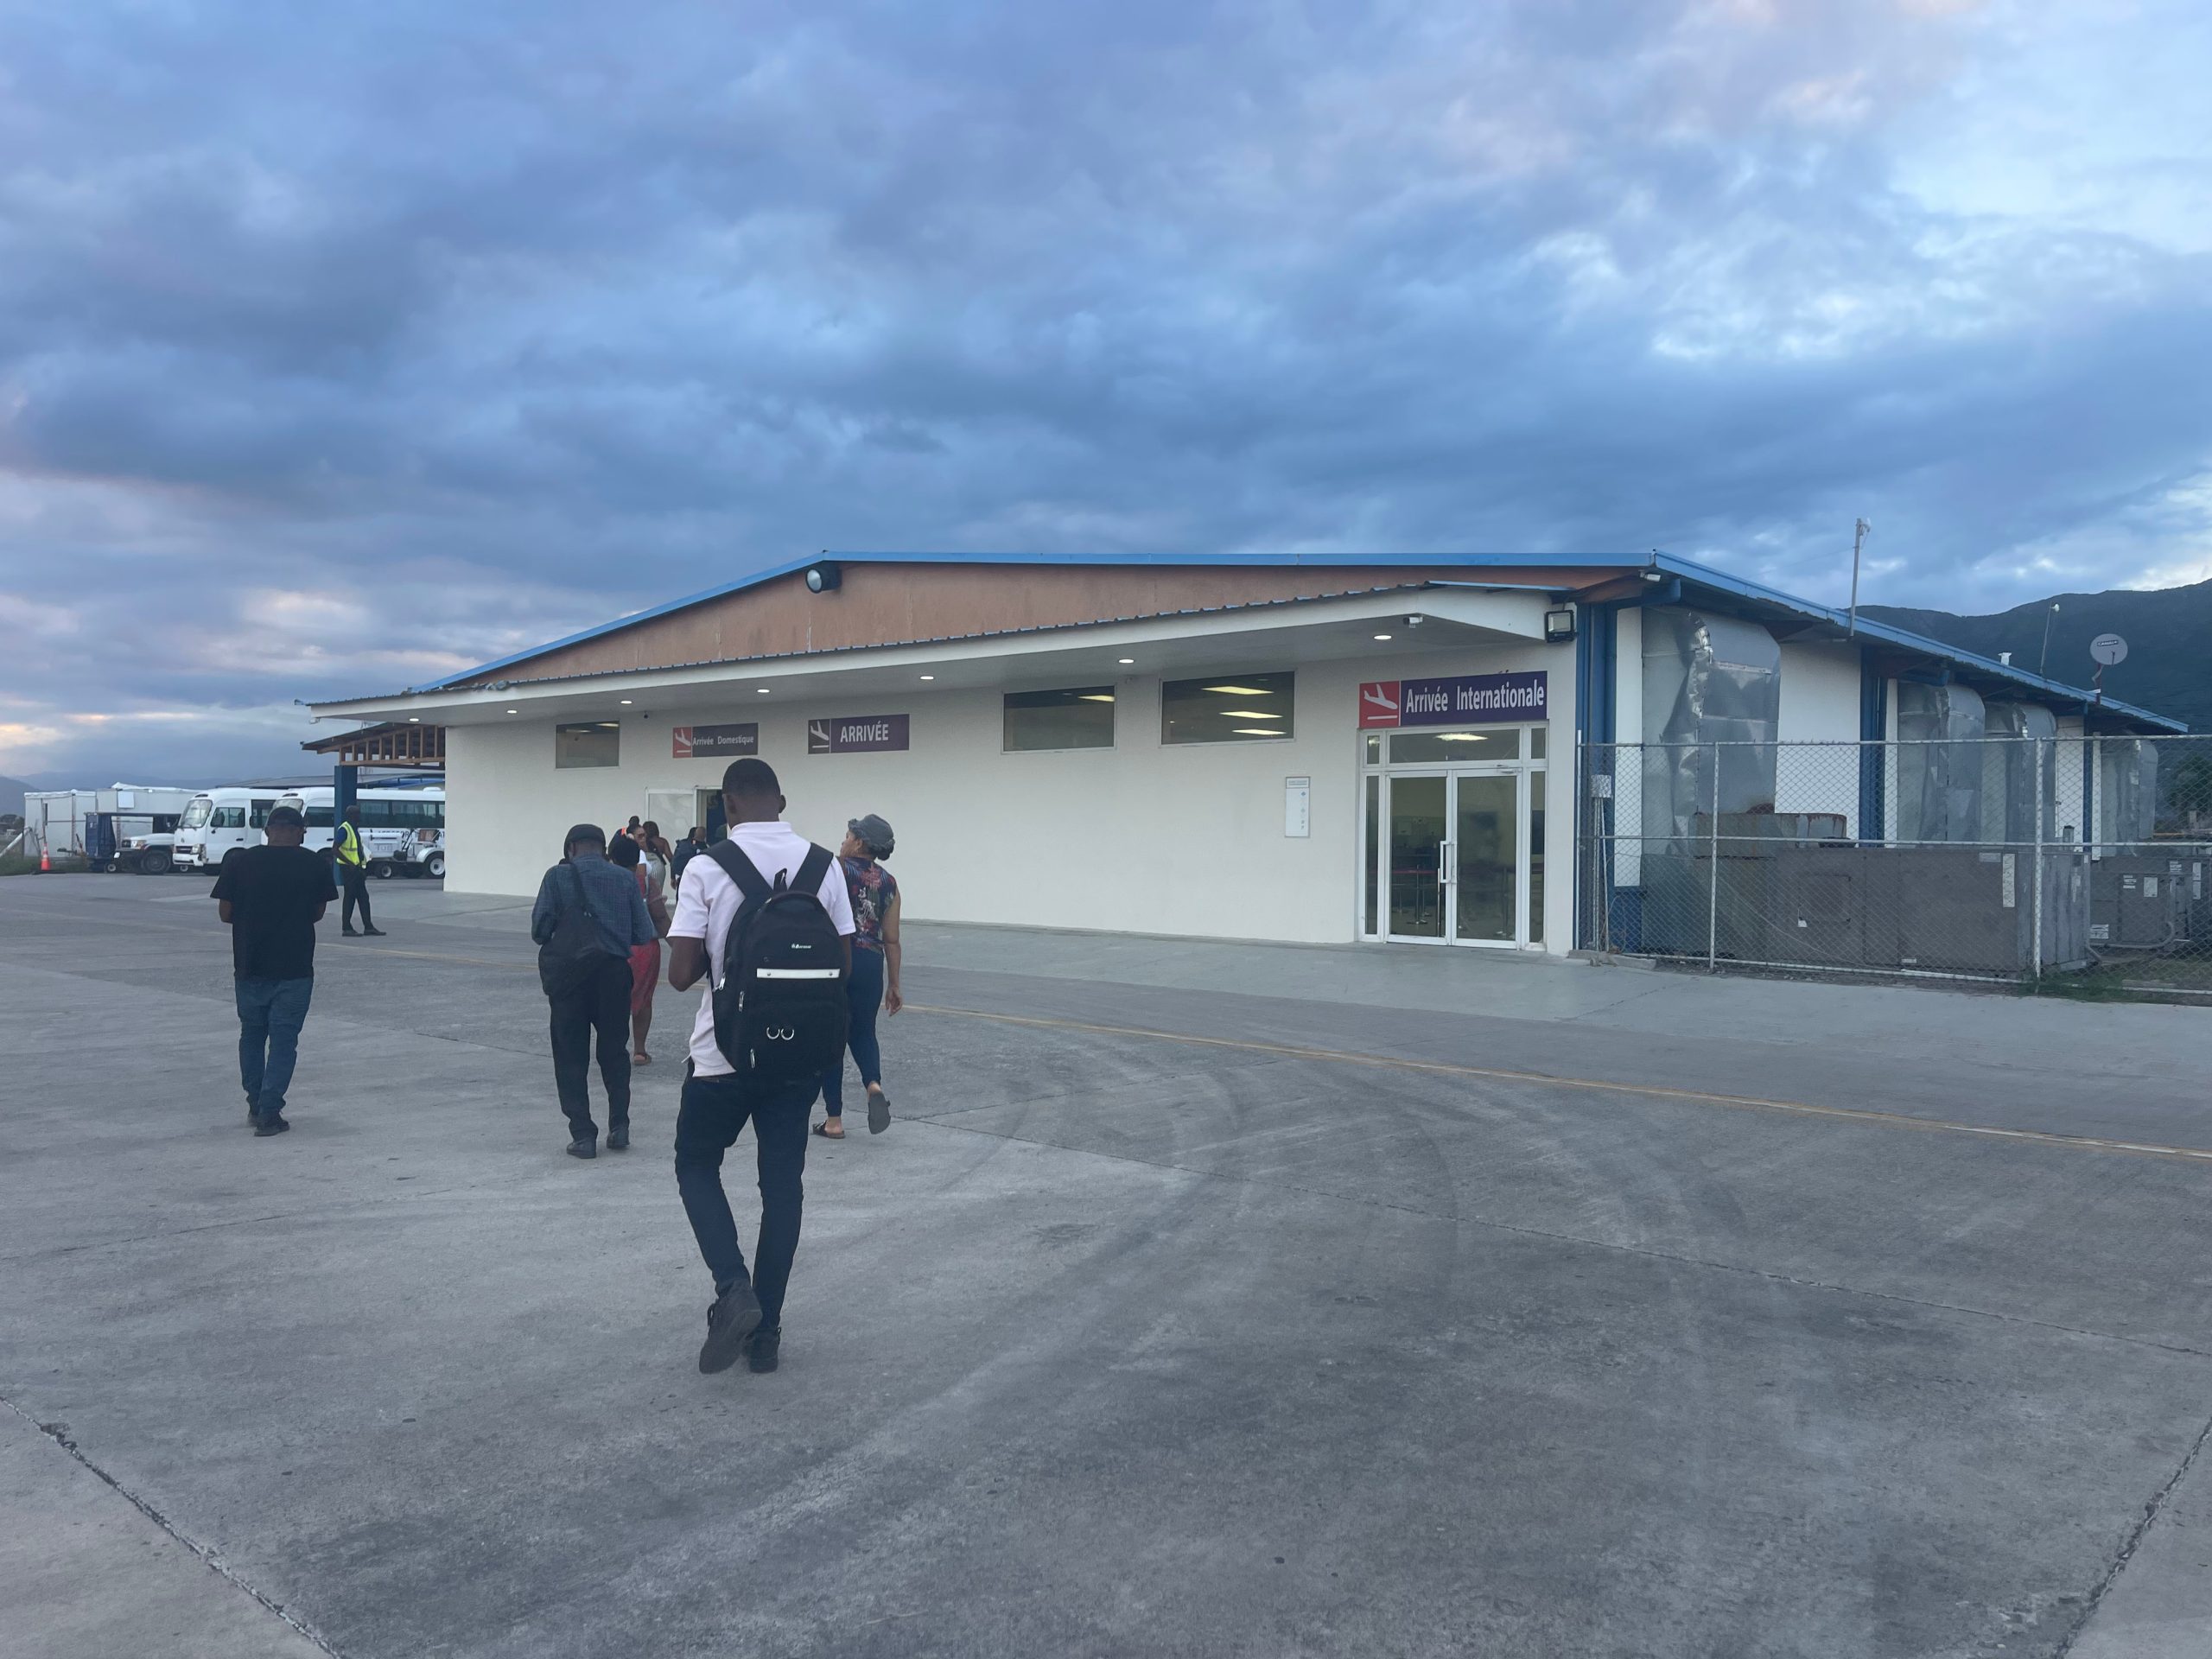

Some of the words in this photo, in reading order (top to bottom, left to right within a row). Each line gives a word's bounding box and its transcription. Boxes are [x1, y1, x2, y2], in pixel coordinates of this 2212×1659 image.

[1405, 685, 1448, 713] Arrivée
[1457, 679, 1544, 710] Internationale
[692, 735, 714, 746] Arrivée
[717, 734, 754, 746] Domestique
[840, 720, 889, 743] ARRIVÉE
